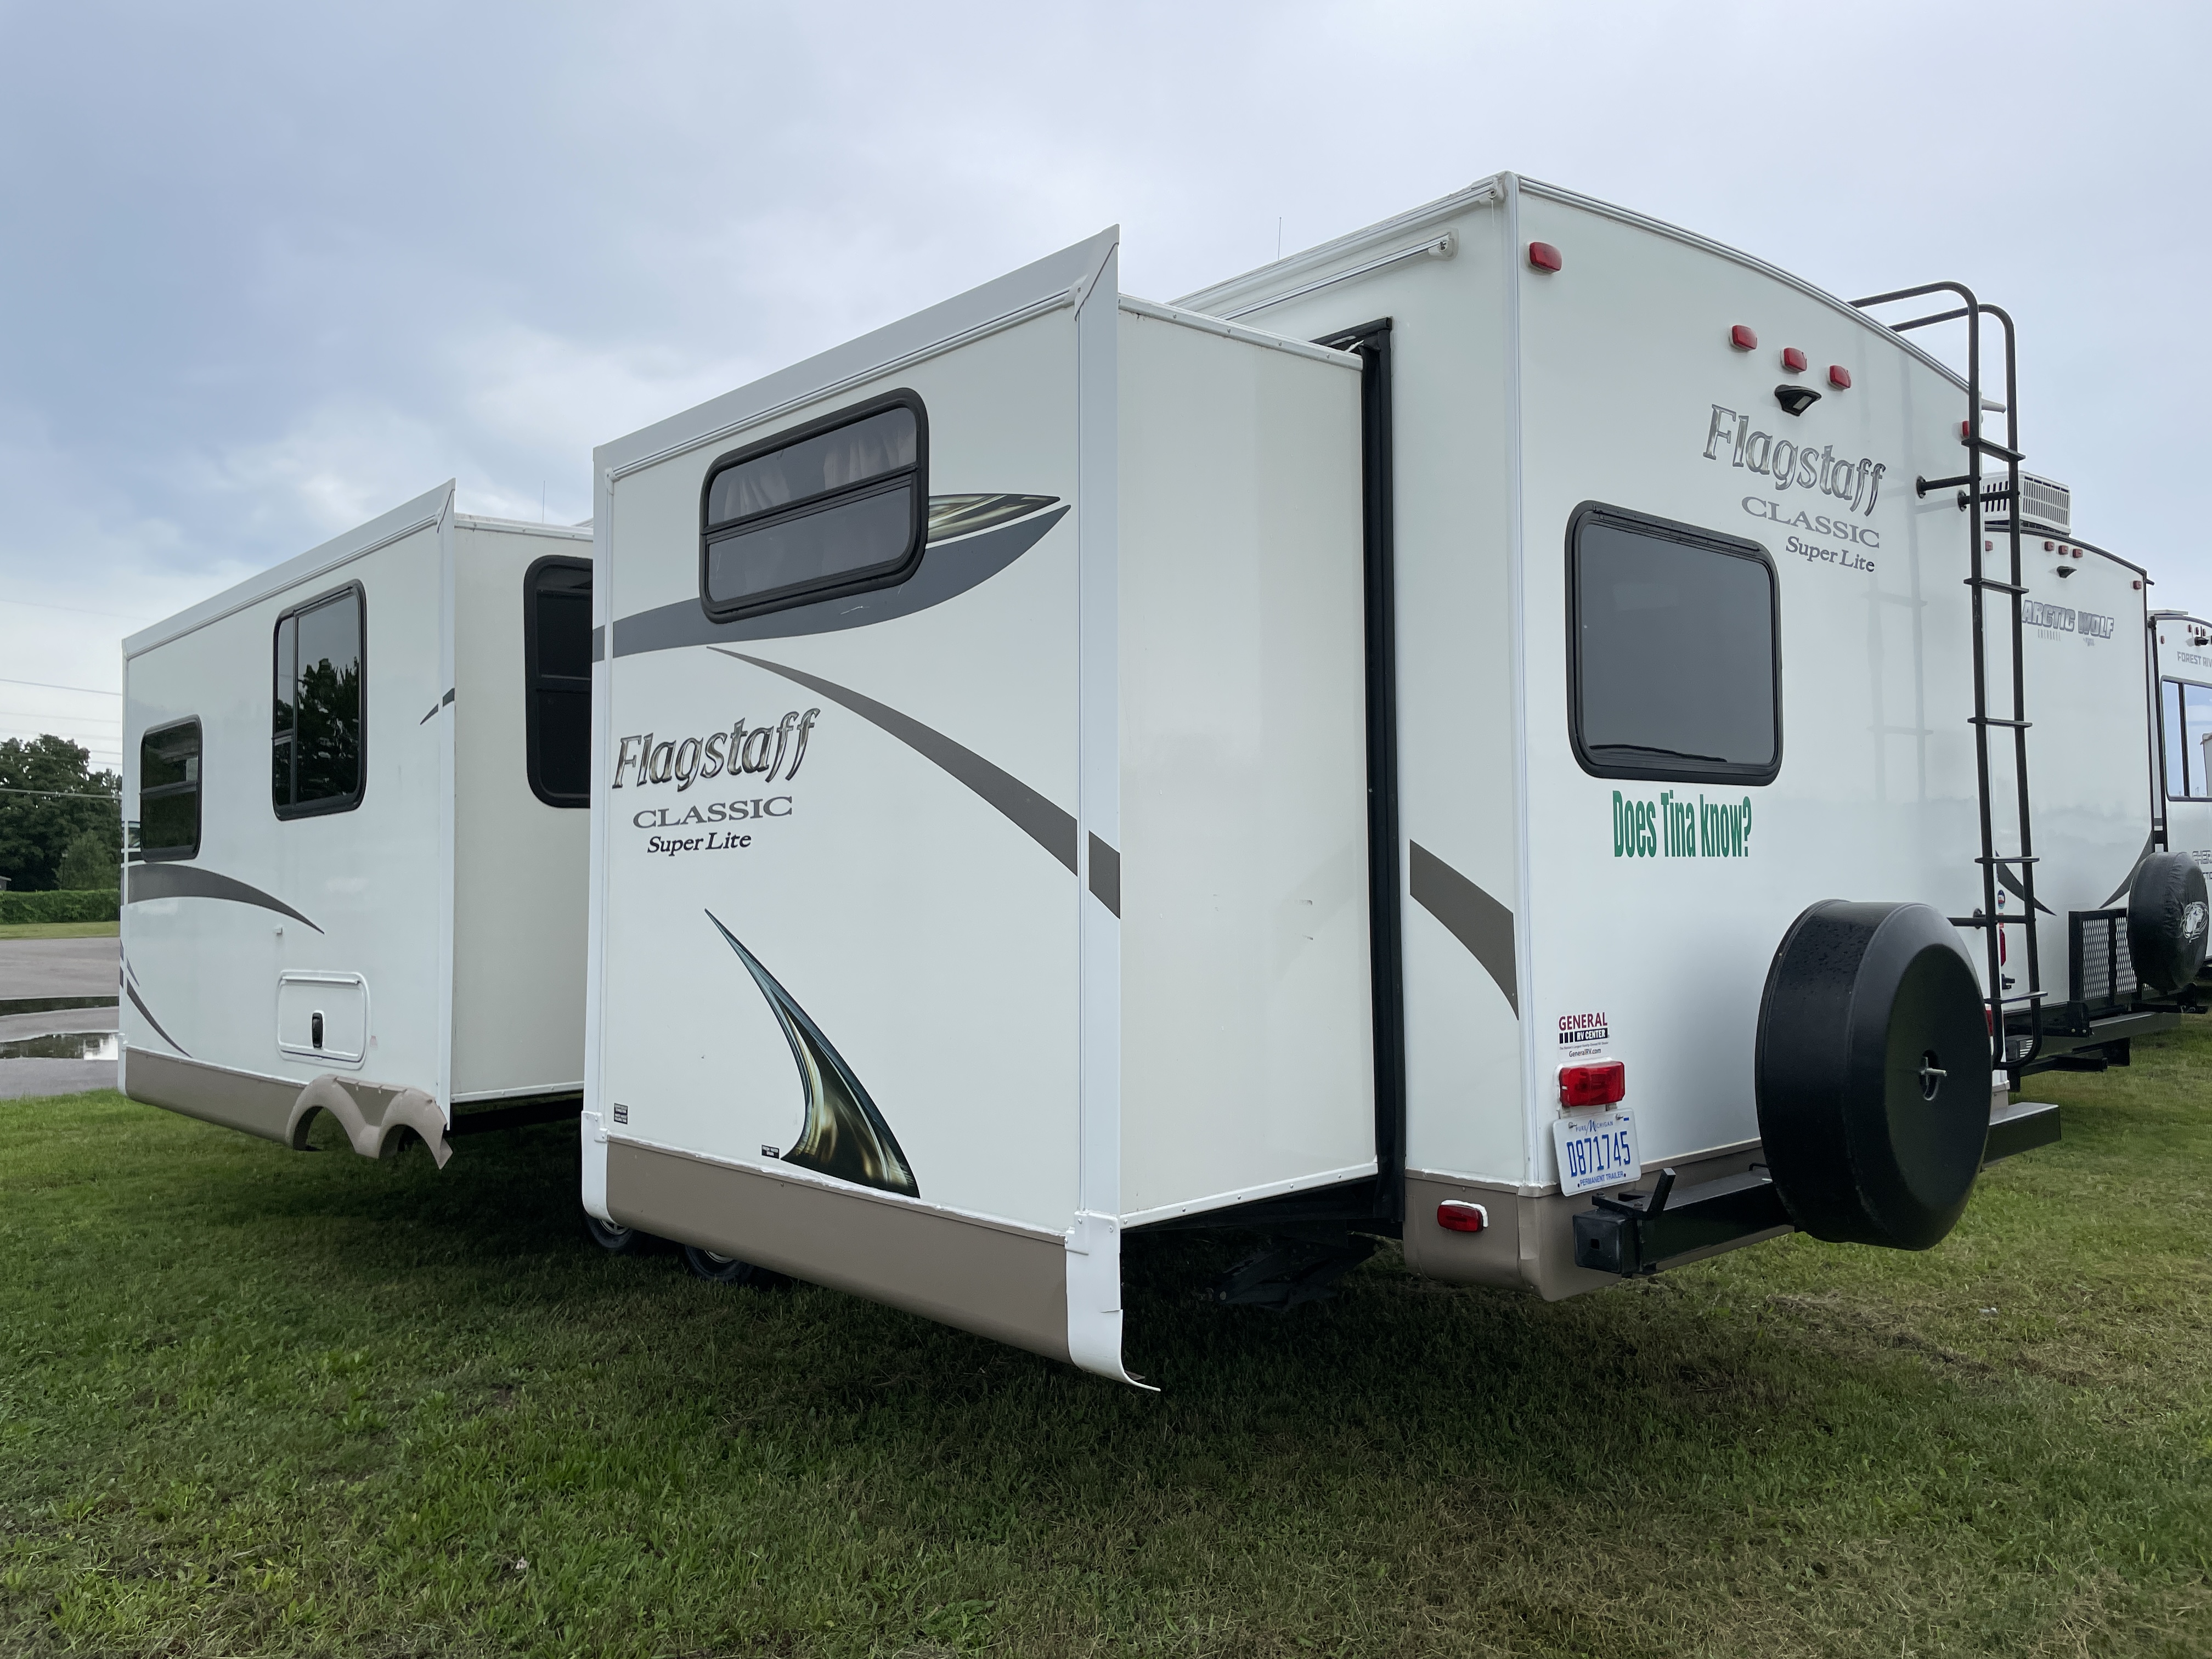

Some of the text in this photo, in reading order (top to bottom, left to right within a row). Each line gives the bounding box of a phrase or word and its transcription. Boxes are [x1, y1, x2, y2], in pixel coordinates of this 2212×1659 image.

[1703, 403, 1886, 517] Flagstaff
[1741, 496, 1880, 548] CLASSIC
[1786, 536, 1875, 572] Super Lite
[2022, 600, 2076, 632] ARCTIC
[2078, 611, 2114, 639] WOLF
[2177, 651, 2202, 665] FOREST
[612, 708, 821, 793] Flagstaff
[633, 795, 793, 829] CLASSIC
[1612, 789, 1752, 857] Does Tina know?
[647, 832, 752, 857] Super Lite
[1559, 1012, 1608, 1031] GENERAL
[1577, 1029, 1606, 1041] RV CENTER
[1569, 1048, 1601, 1057] GeneralRV.com
[1585, 1119, 1613, 1136] MICHIGAN
[1579, 1171, 1624, 1186] PERMANENT TRAILER
